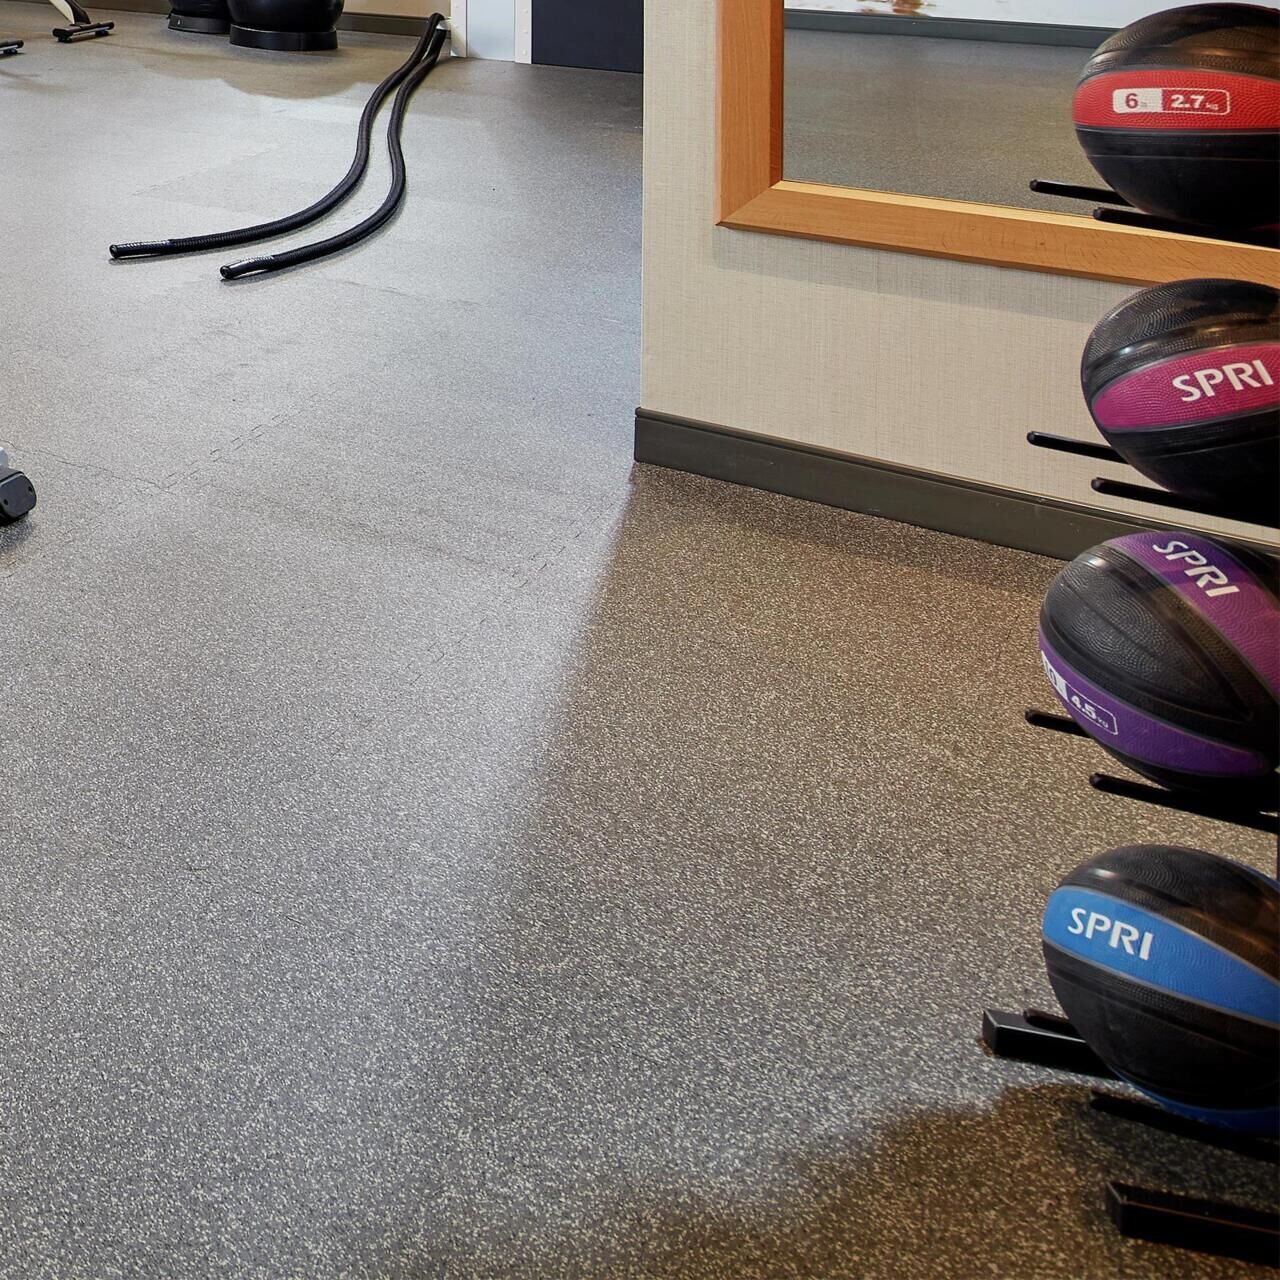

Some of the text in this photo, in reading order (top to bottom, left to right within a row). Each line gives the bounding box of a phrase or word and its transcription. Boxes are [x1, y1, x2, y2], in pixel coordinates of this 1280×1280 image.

[1125, 92, 1139, 109] 6
[1172, 359, 1274, 402] SPRI
[1151, 540, 1240, 598] SPRI
[1067, 907, 1154, 961] SPRI
